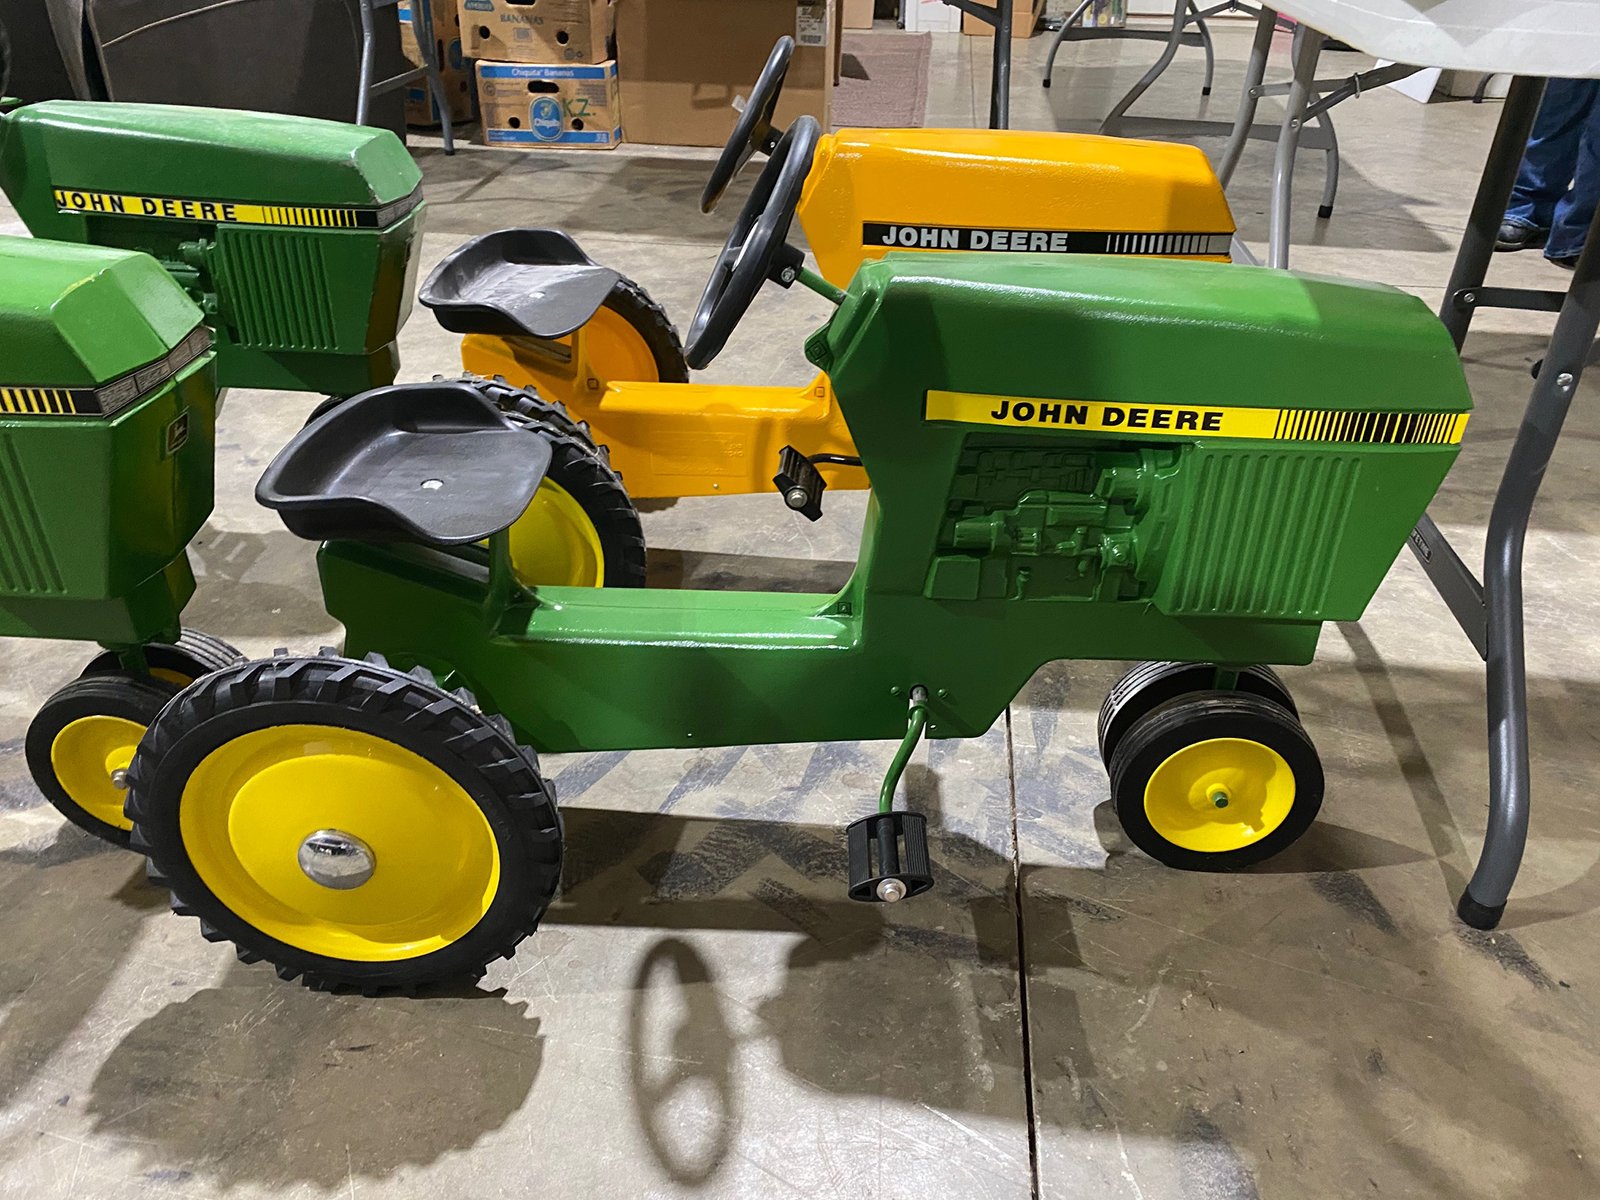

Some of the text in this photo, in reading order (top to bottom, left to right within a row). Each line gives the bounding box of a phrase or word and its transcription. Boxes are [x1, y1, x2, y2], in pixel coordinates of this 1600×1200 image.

[500, 13, 544, 25] BANANAS
[57, 191, 237, 222] JOHN DEERE
[881, 226, 1069, 252] JOHN DEERE
[991, 400, 1224, 432] JOHN DEERE
